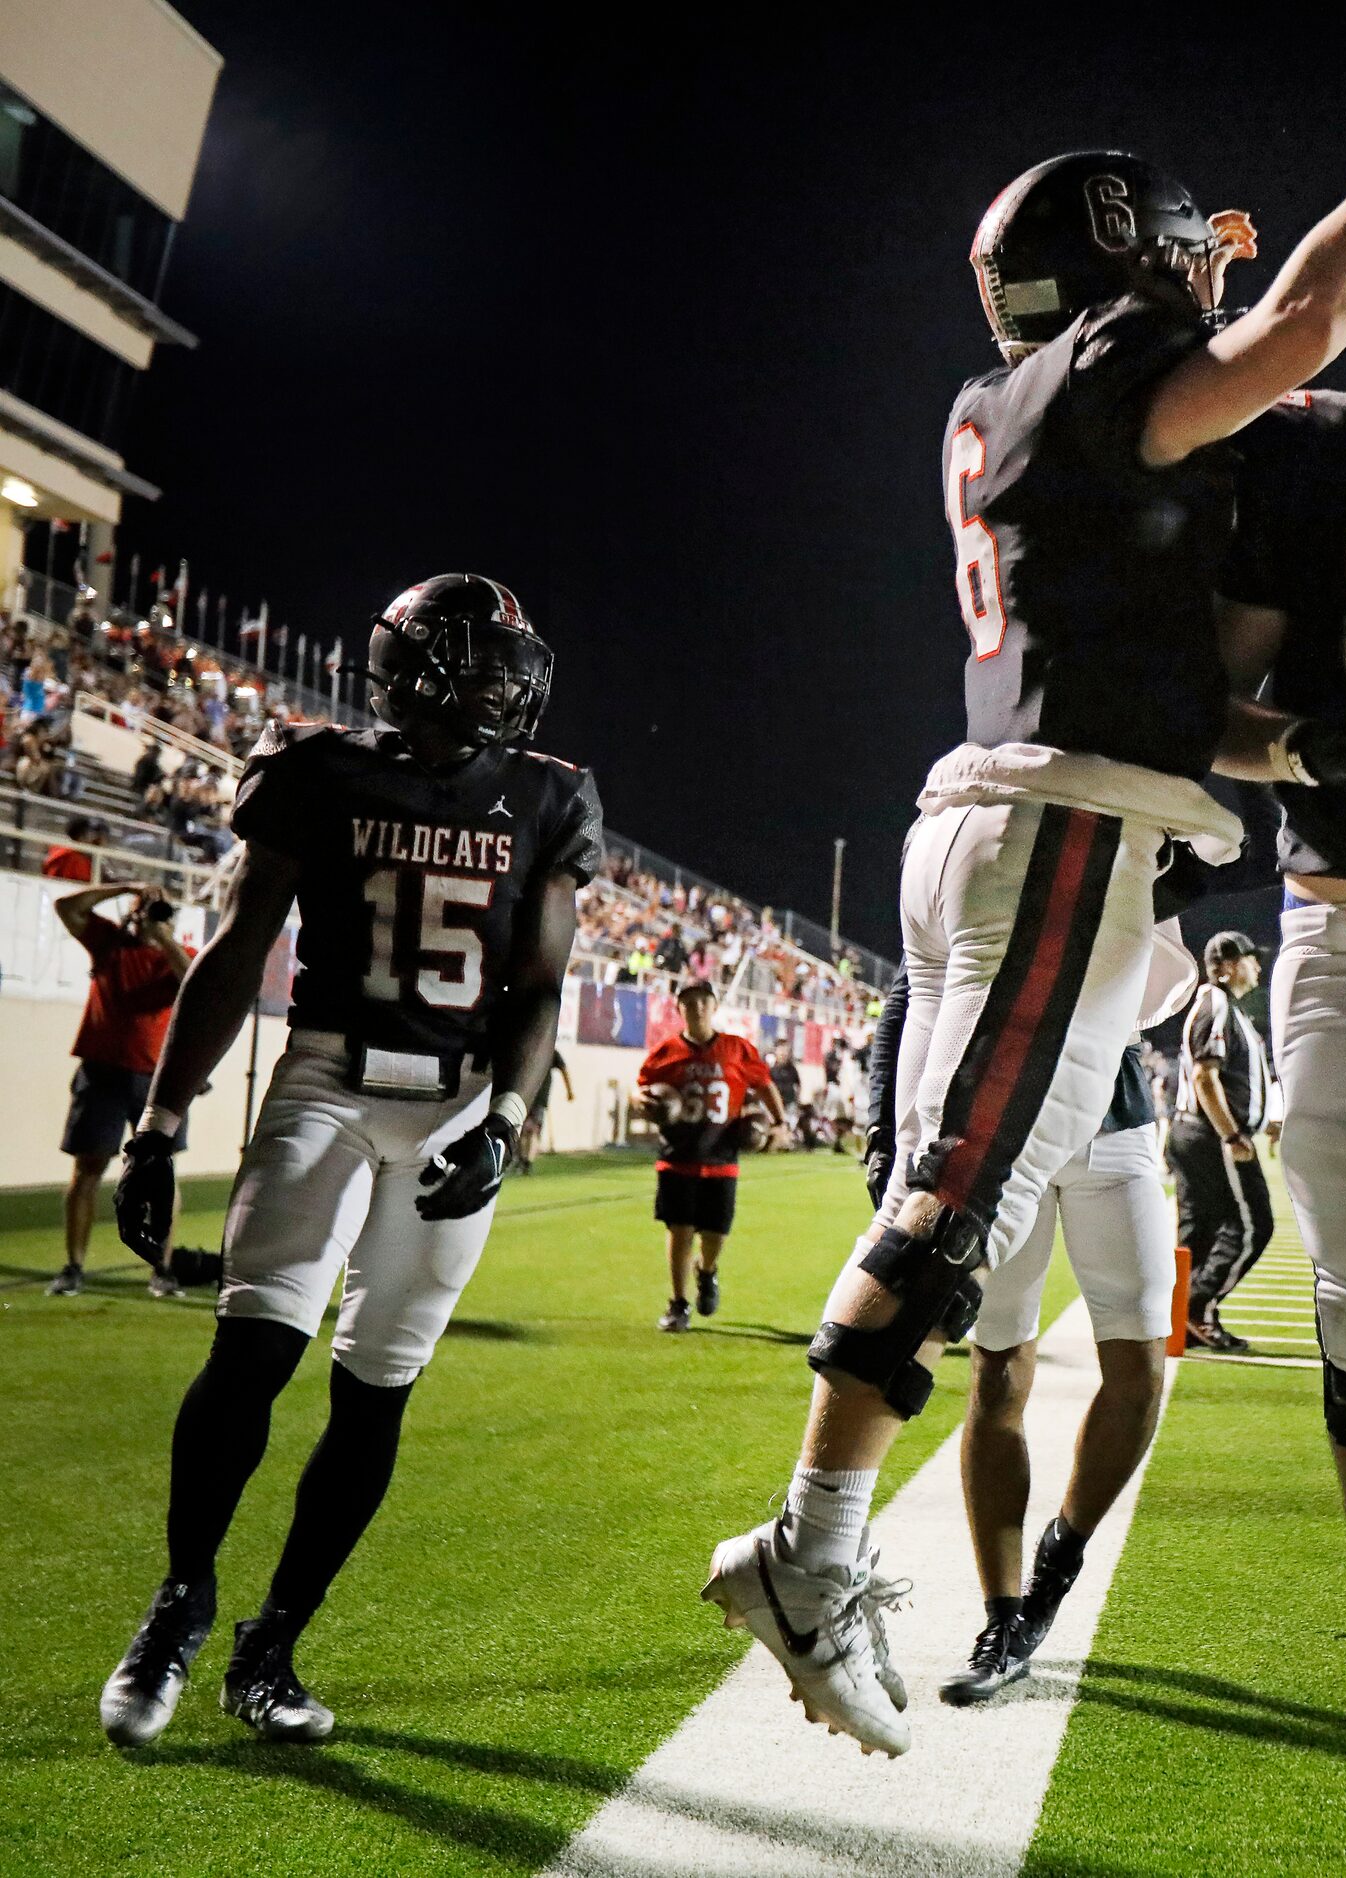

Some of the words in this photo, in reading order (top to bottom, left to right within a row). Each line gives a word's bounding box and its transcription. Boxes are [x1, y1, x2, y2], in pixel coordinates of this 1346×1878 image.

[1085, 175, 1136, 252] 6
[947, 421, 1006, 663] 6
[352, 818, 512, 873] WILDCATS
[362, 869, 496, 1011] 15
